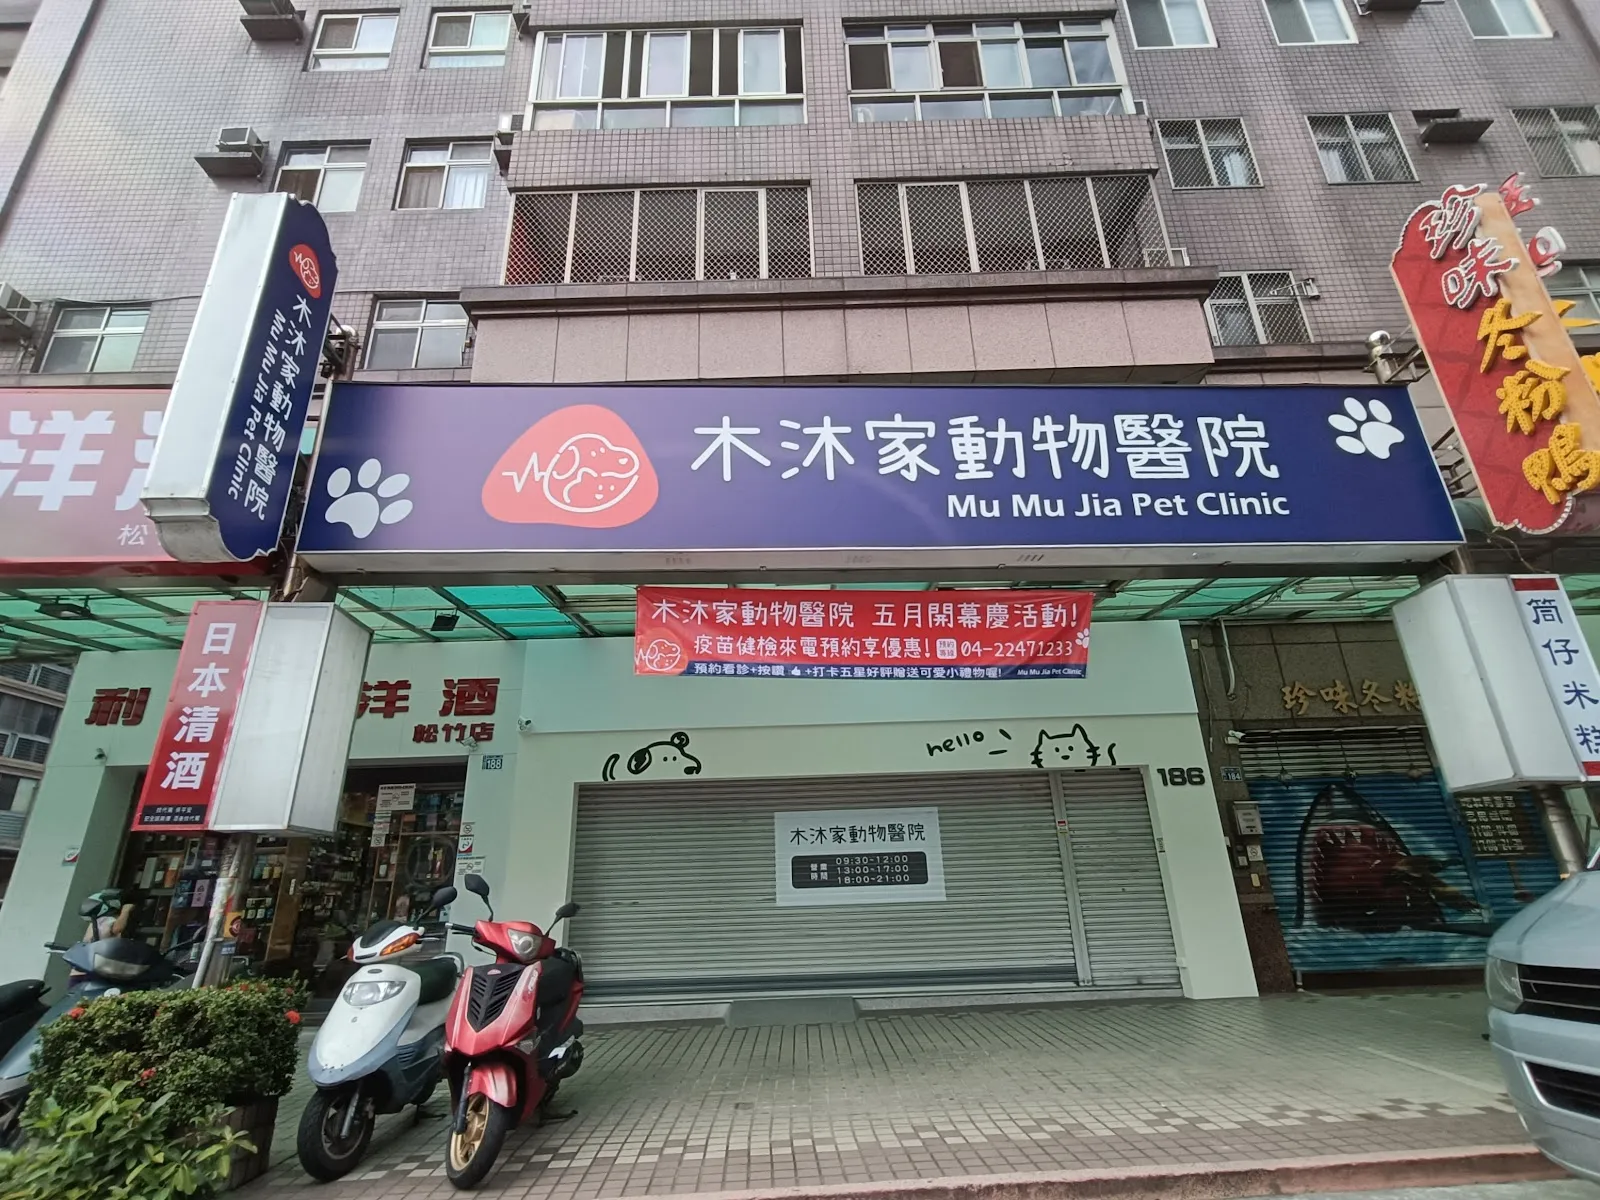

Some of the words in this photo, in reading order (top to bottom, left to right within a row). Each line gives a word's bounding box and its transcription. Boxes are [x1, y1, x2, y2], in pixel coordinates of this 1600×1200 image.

[270, 308, 286, 341] Mu
[261, 341, 278, 374] Mu
[254, 373, 269, 403] Jia
[244, 294, 312, 520] 木沐家動物醫院
[244, 405, 262, 441] Pet
[691, 413, 1279, 481] 木沐家動物醫院
[228, 442, 252, 501] Clinic
[948, 494, 1000, 518] Mu
[1012, 494, 1065, 517] Mu
[1074, 493, 1122, 517] Jia
[1131, 492, 1188, 516] Pet
[1196, 491, 1290, 515] Clinic
[652, 599, 854, 628] 木沐家動物醫院
[872, 602, 1077, 629] 五月開幕慶活動!
[694, 634, 930, 660] 疫苗健檢來電預約享優惠!
[961, 640, 1073, 658] 04-22471233
[85, 687, 151, 726] 利
[356, 678, 500, 719] 洋酒
[160, 623, 236, 789] 日本清酒
[412, 722, 495, 743] 松竹店
[487, 759, 501, 769] 188
[1156, 768, 1206, 787] 186
[1227, 772, 1240, 780] 184
[790, 823, 926, 846] 木沐家動物醫院
[810, 872, 828, 881] 時間
